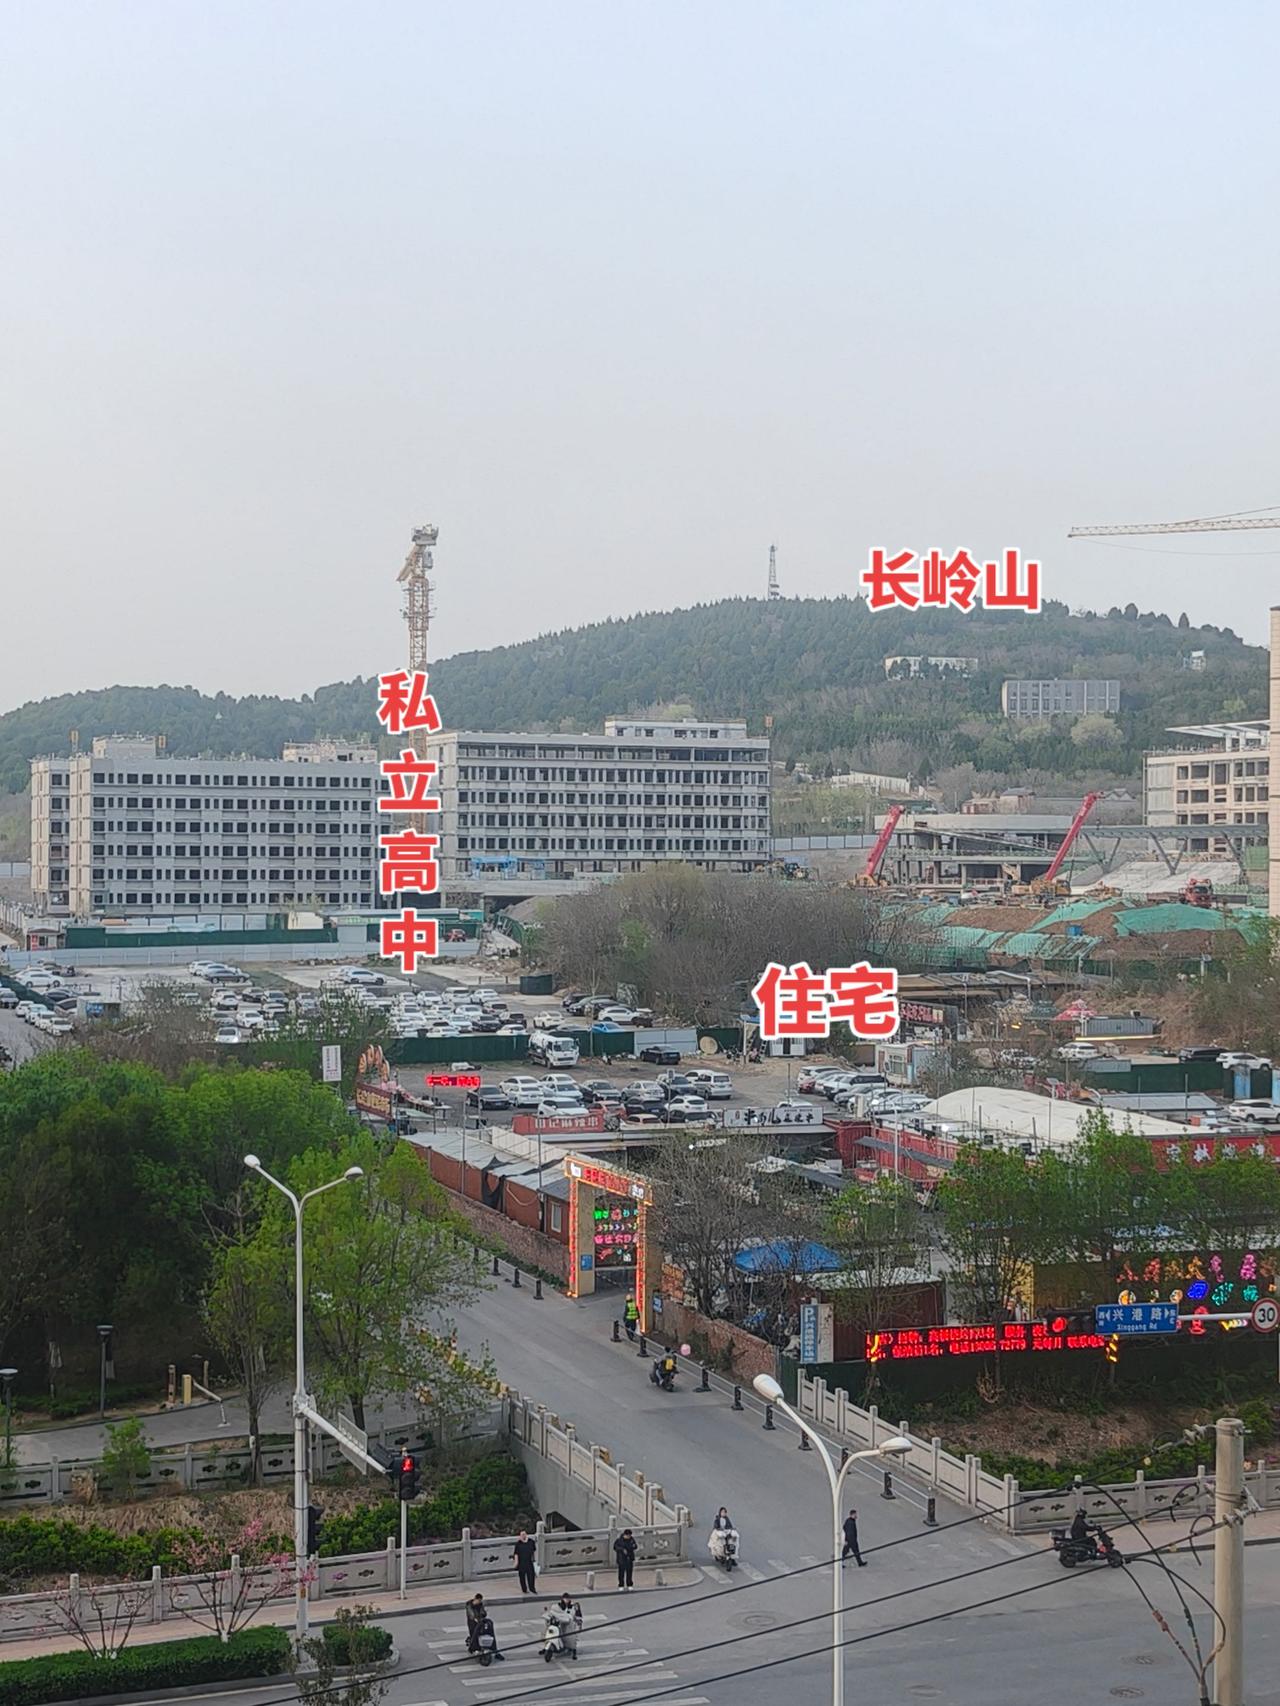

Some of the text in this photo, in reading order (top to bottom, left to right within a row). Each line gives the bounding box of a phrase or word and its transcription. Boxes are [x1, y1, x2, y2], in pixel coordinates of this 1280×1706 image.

[1112, 1307, 1163, 1322] 兴港路
[1258, 1307, 1275, 1323] 30
[1116, 1322, 1158, 1332] Xinggang Rd
